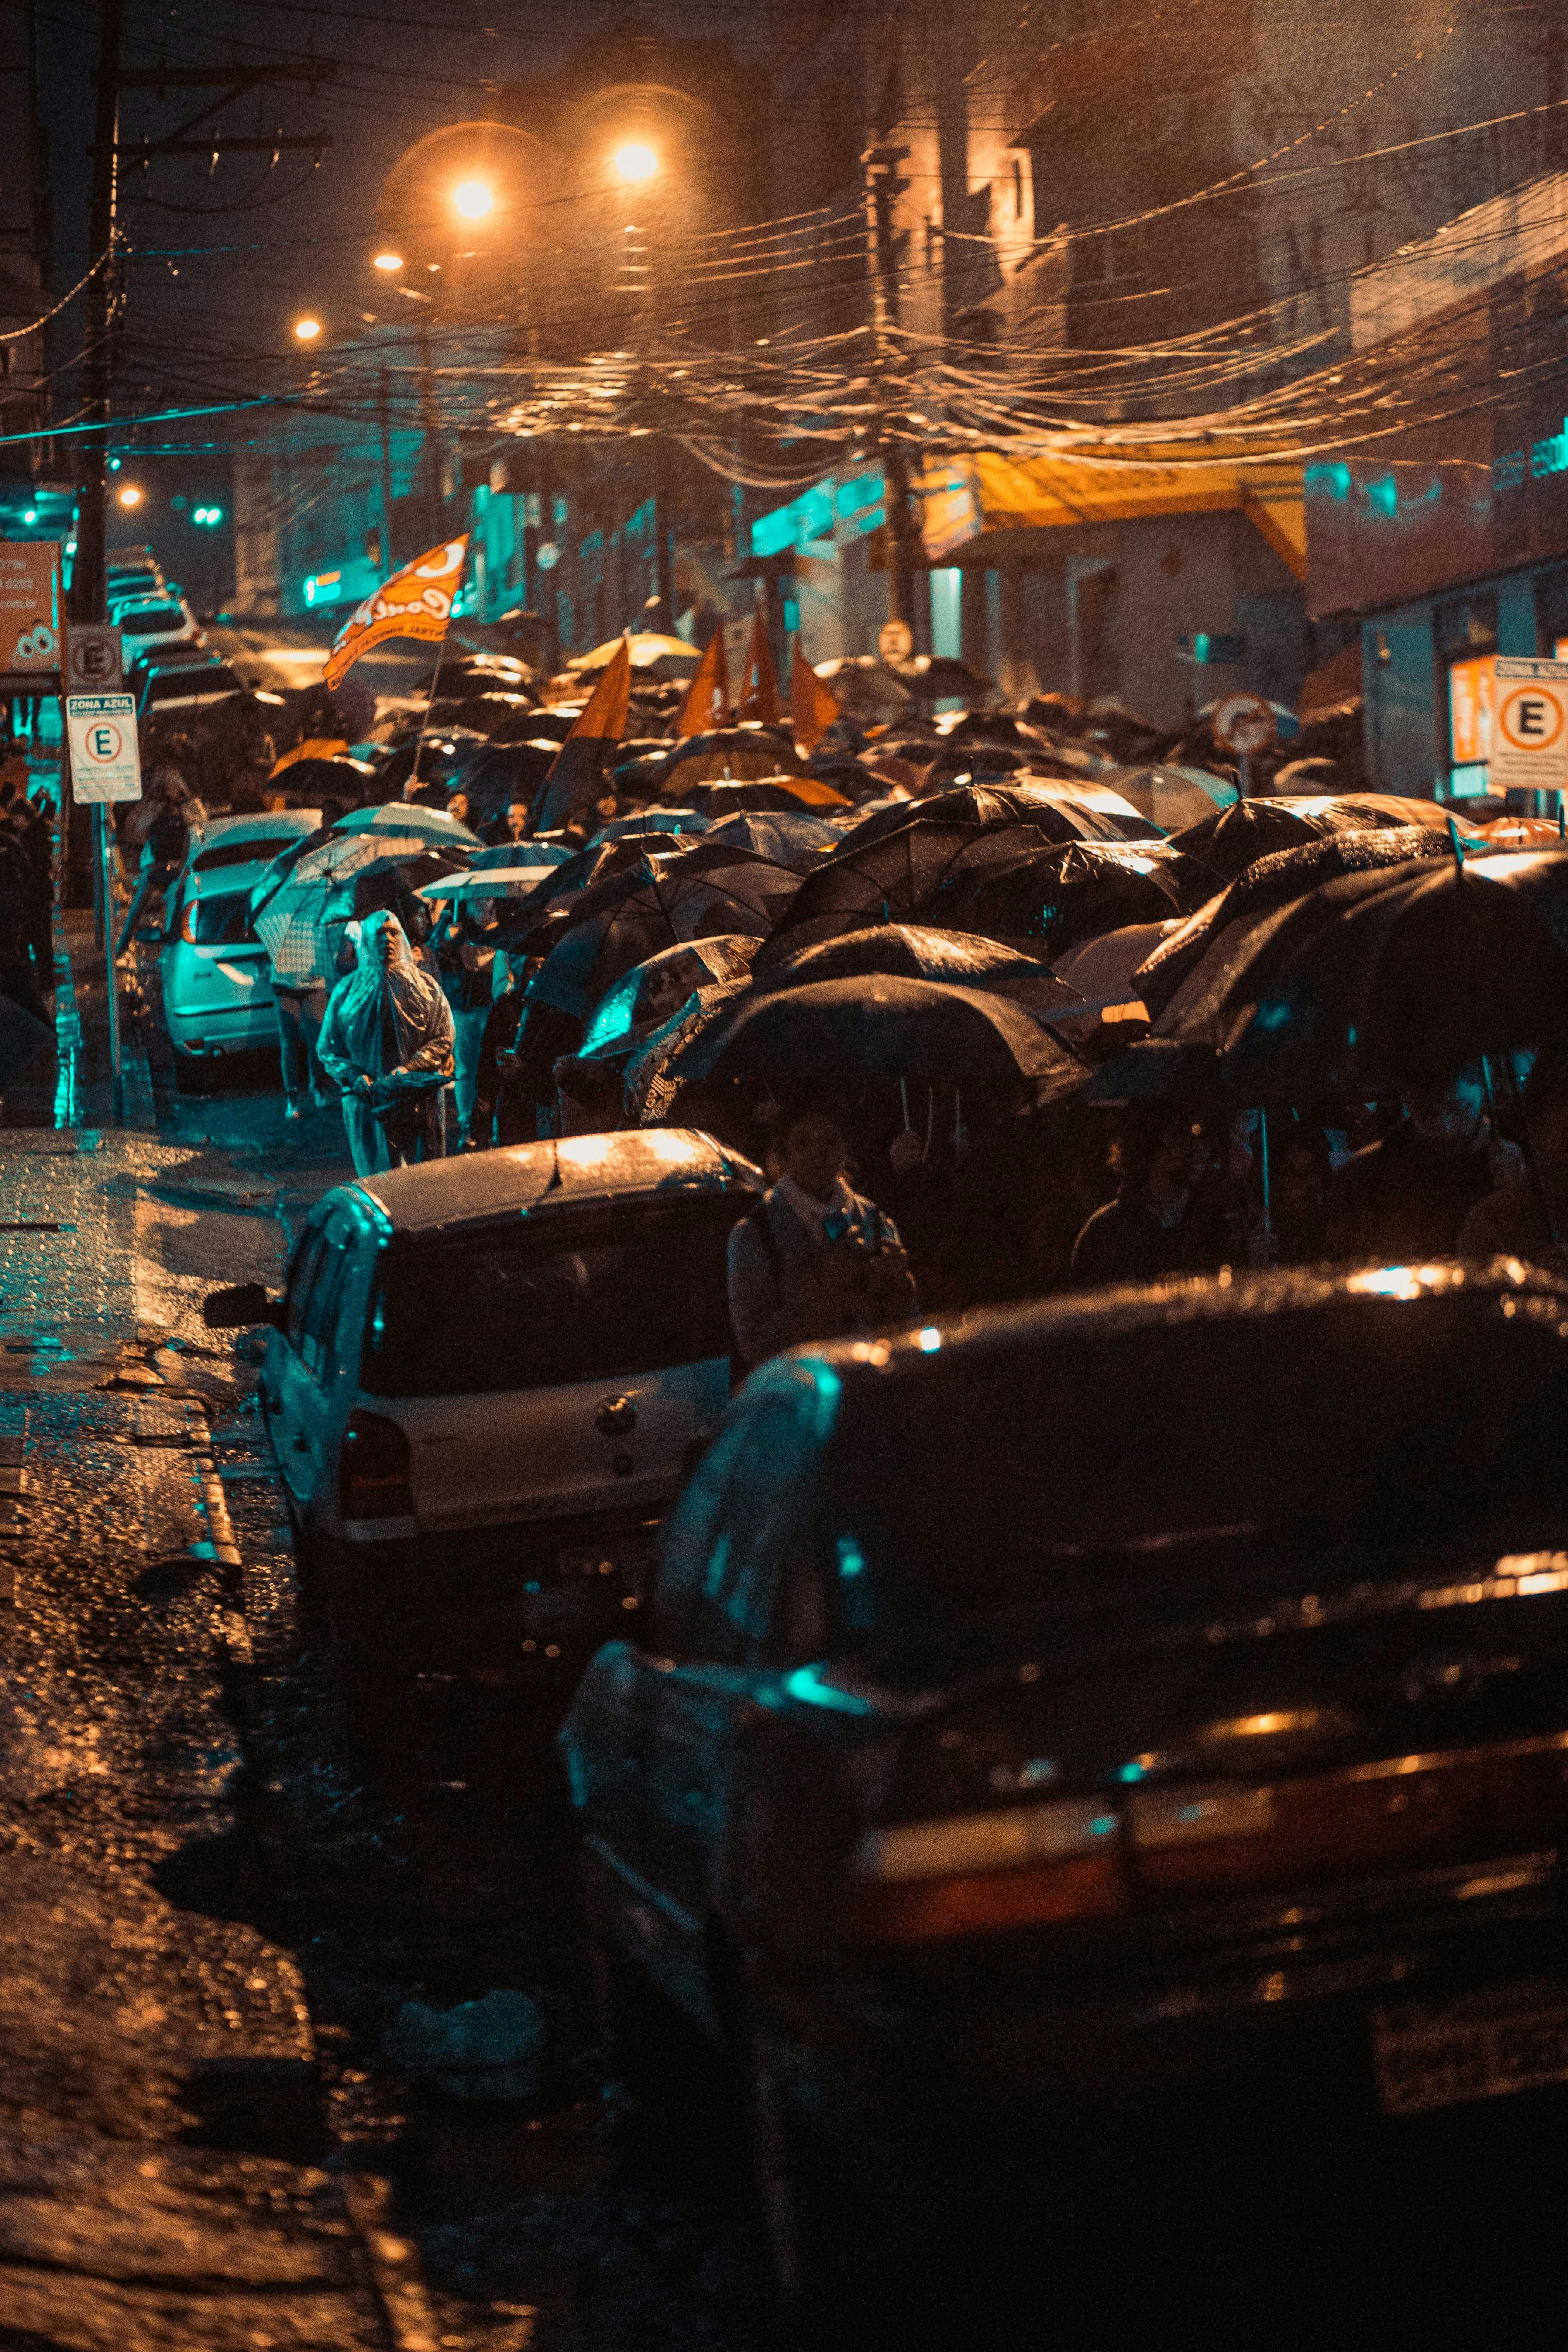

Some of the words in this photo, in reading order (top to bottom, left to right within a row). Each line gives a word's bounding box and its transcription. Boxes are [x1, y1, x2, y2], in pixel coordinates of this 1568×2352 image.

[84, 646, 104, 674] E
[71, 700, 101, 710] ZONA
[103, 698, 132, 708] AZUL
[1520, 701, 1544, 734] E
[95, 730, 112, 755] E
